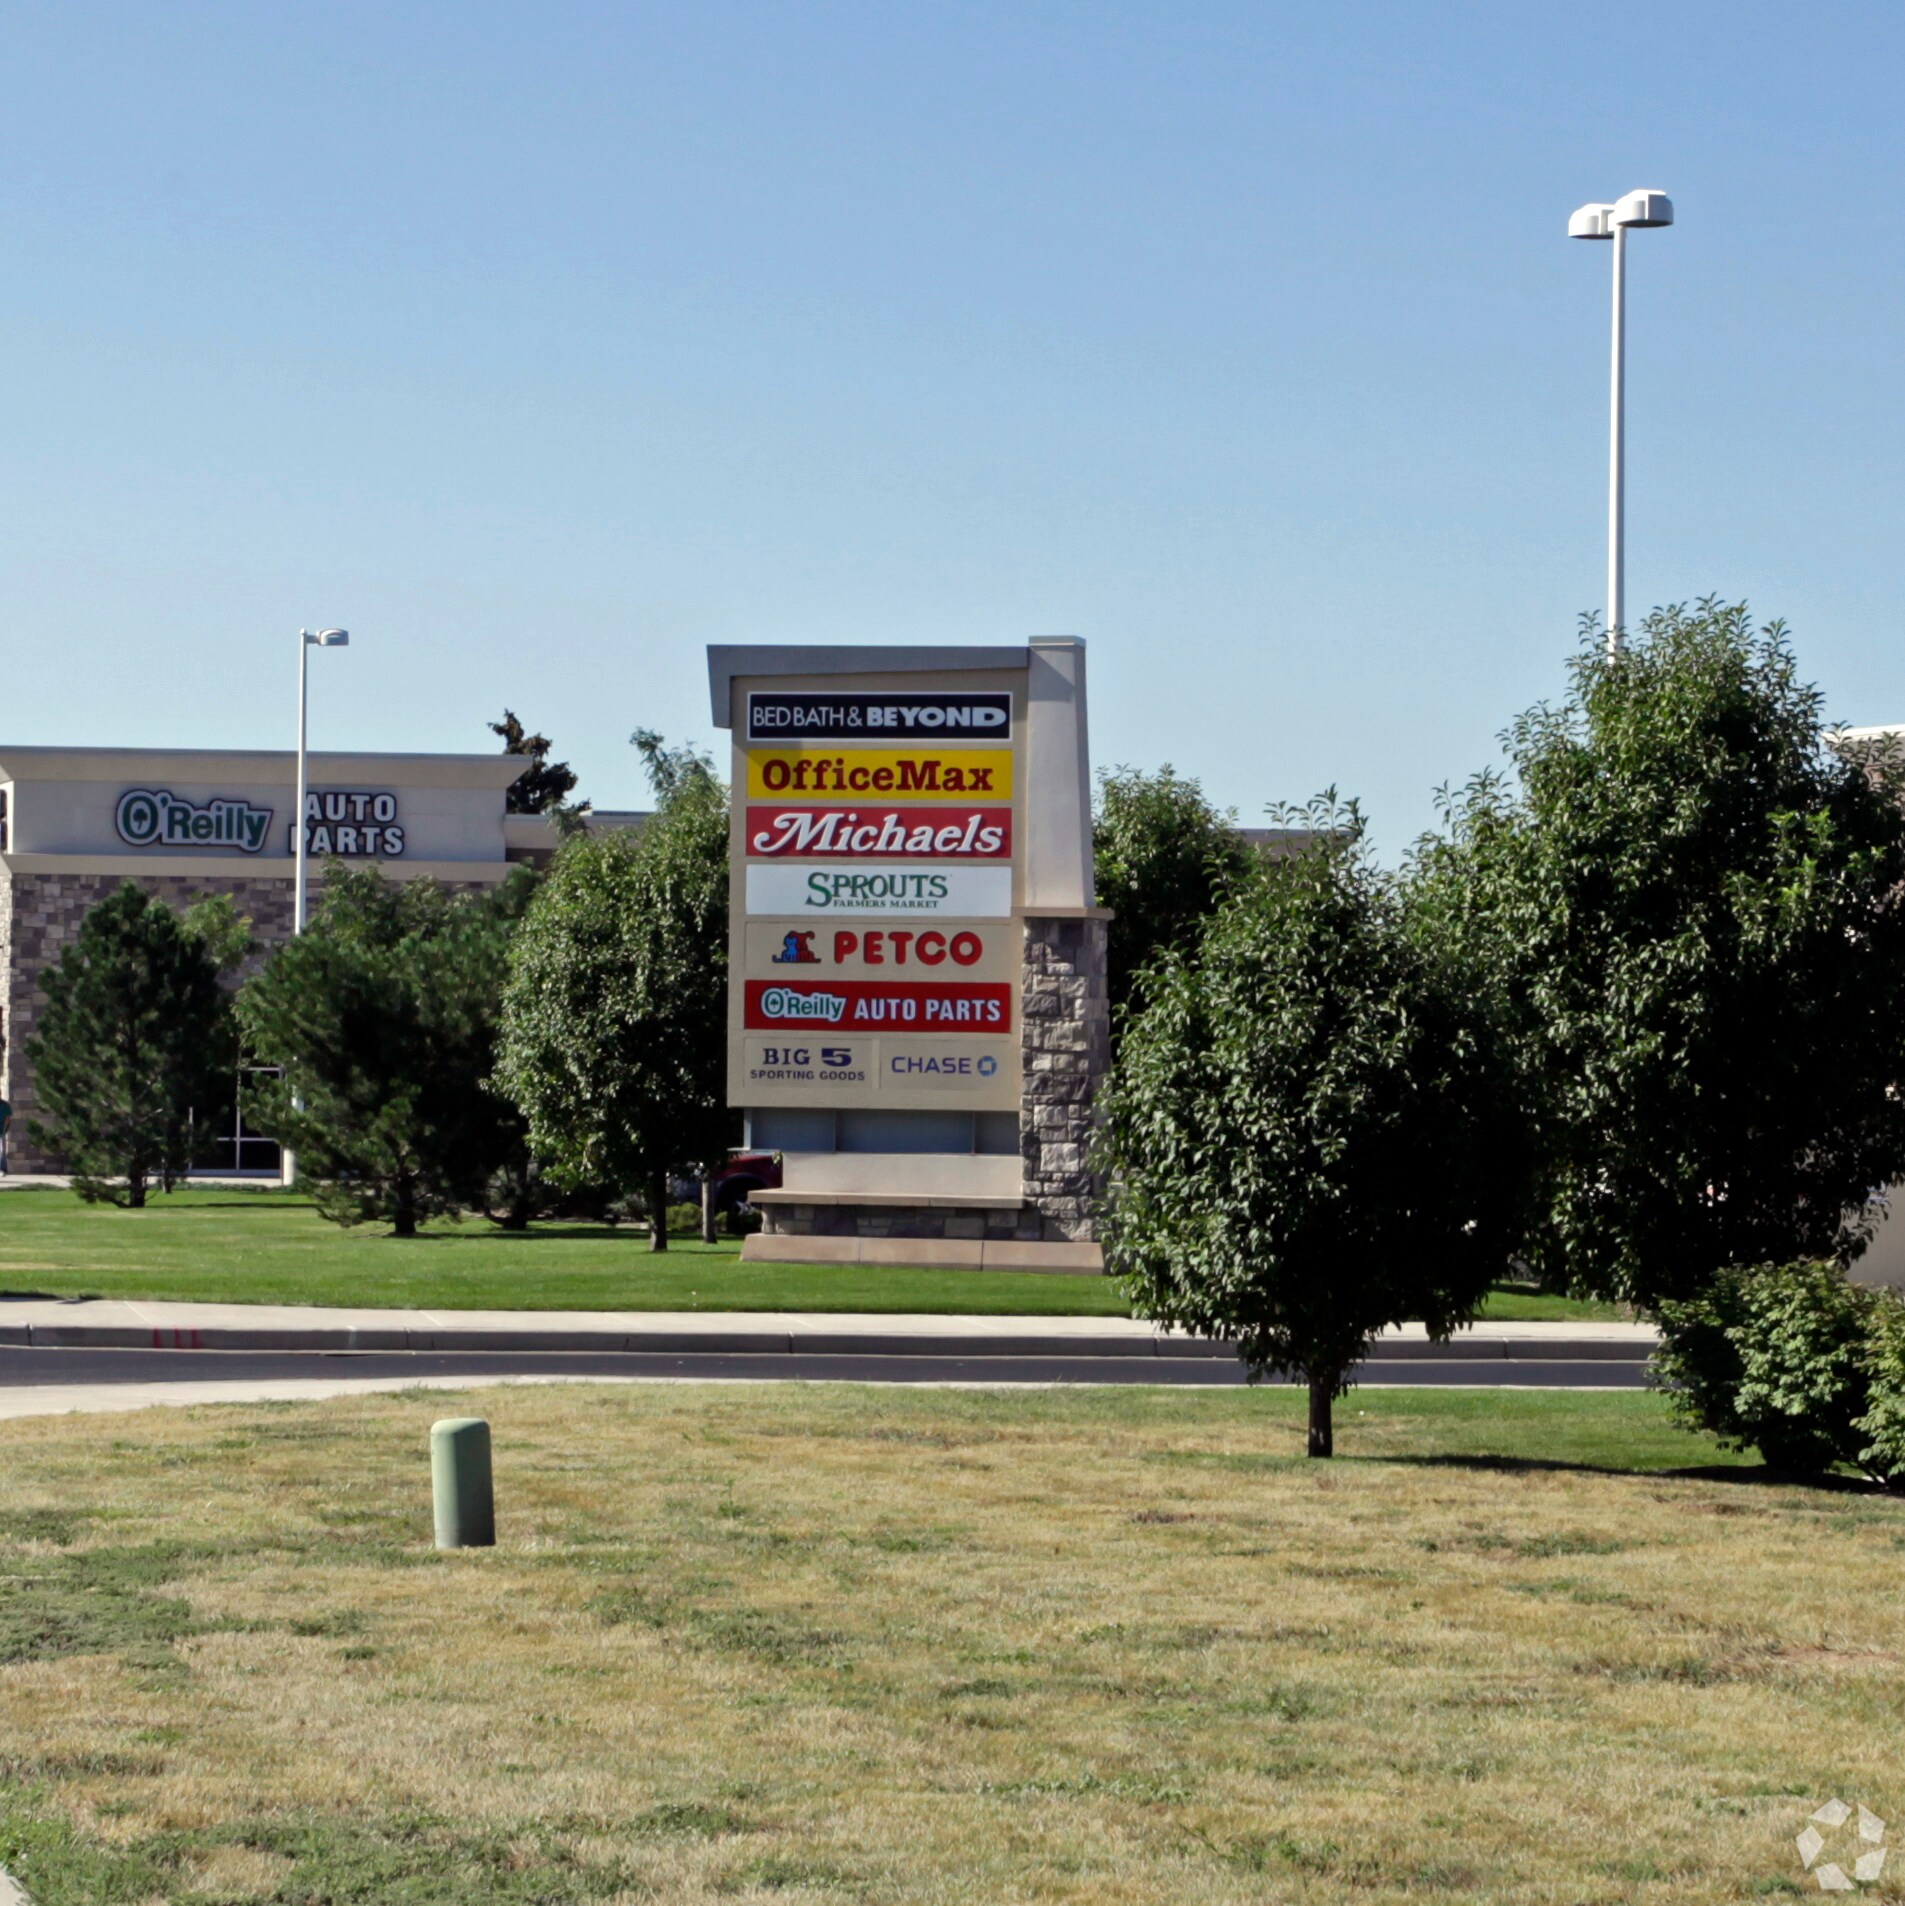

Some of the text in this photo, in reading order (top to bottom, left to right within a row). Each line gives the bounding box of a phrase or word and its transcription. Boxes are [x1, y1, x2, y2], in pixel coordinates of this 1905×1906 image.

[753, 707, 1006, 727] BED BATH & BEYOND
[762, 758, 993, 792] OfficeMax
[121, 795, 267, 847] O'Reilly
[305, 794, 395, 821] AUTO
[753, 813, 1003, 853] Michaels
[804, 872, 948, 907] SPROUTS
[833, 900, 939, 908] FARMERS MARKET
[833, 931, 983, 966] PETCO
[763, 989, 1001, 1021] O'Reilly AUTO PARTS
[763, 1047, 852, 1067] BIG 5
[891, 1056, 972, 1074] CHASE
[750, 1069, 865, 1081] SPORTING GOODS
